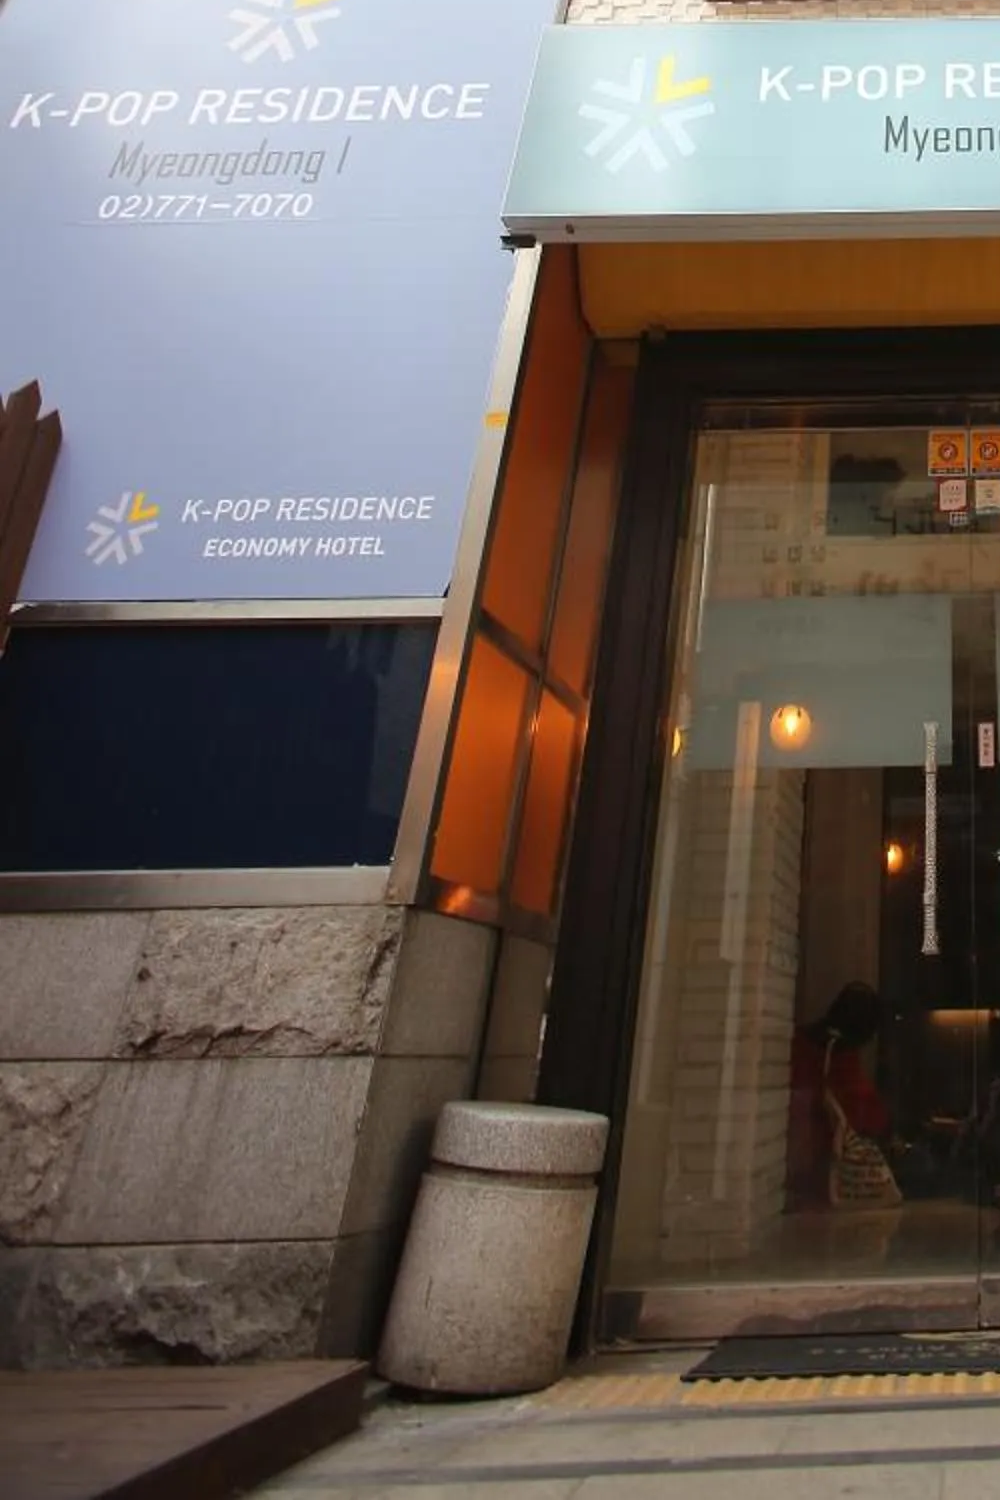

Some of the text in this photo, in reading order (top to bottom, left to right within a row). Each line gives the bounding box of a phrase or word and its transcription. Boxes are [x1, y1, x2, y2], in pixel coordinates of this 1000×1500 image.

[759, 62, 926, 102] K-POP
[10, 83, 490, 129] K-POP RESIDENCE
[109, 140, 325, 185] Myeongdong
[98, 192, 313, 220] 02)771-7070
[181, 495, 434, 523] K-POP RESIDENCE
[203, 534, 386, 558] ECONOMY HOTEL
